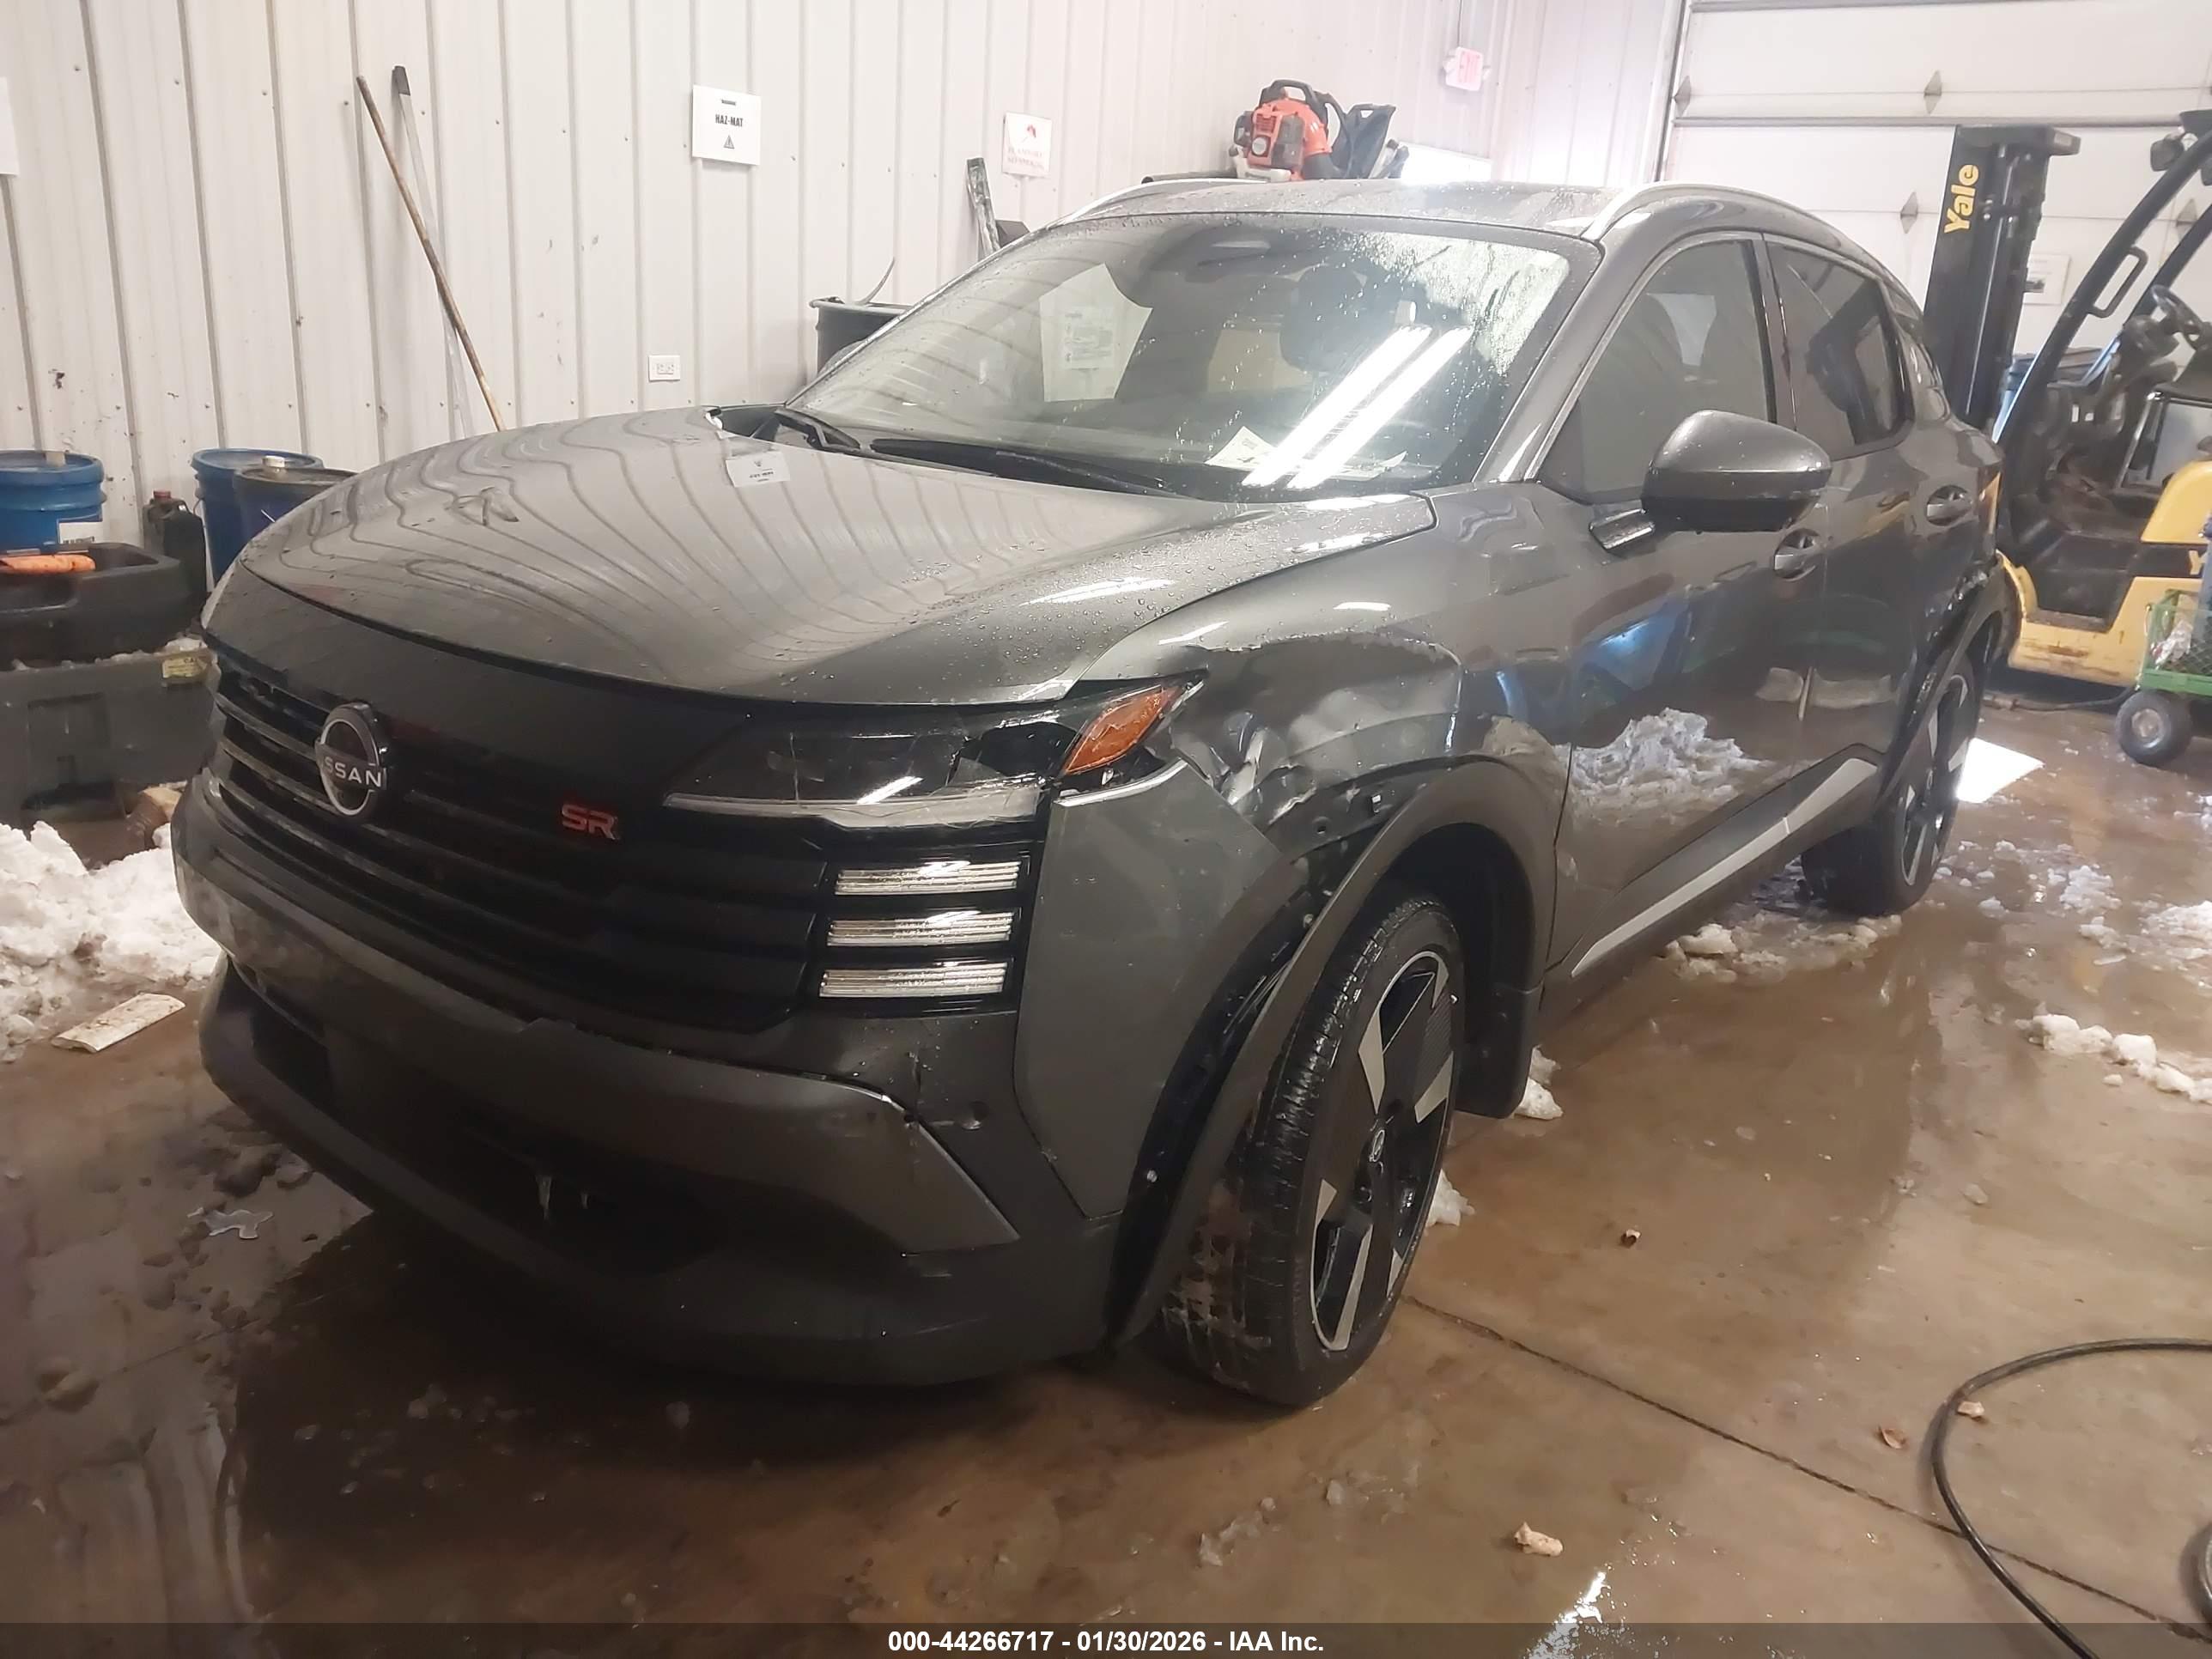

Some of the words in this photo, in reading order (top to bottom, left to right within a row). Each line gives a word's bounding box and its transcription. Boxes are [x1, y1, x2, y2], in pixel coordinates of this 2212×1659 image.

[714, 113, 744, 128] HAZ-MAT
[1943, 164, 1979, 234] Yale
[324, 756, 382, 788] SSAN
[562, 804, 616, 840] SR
